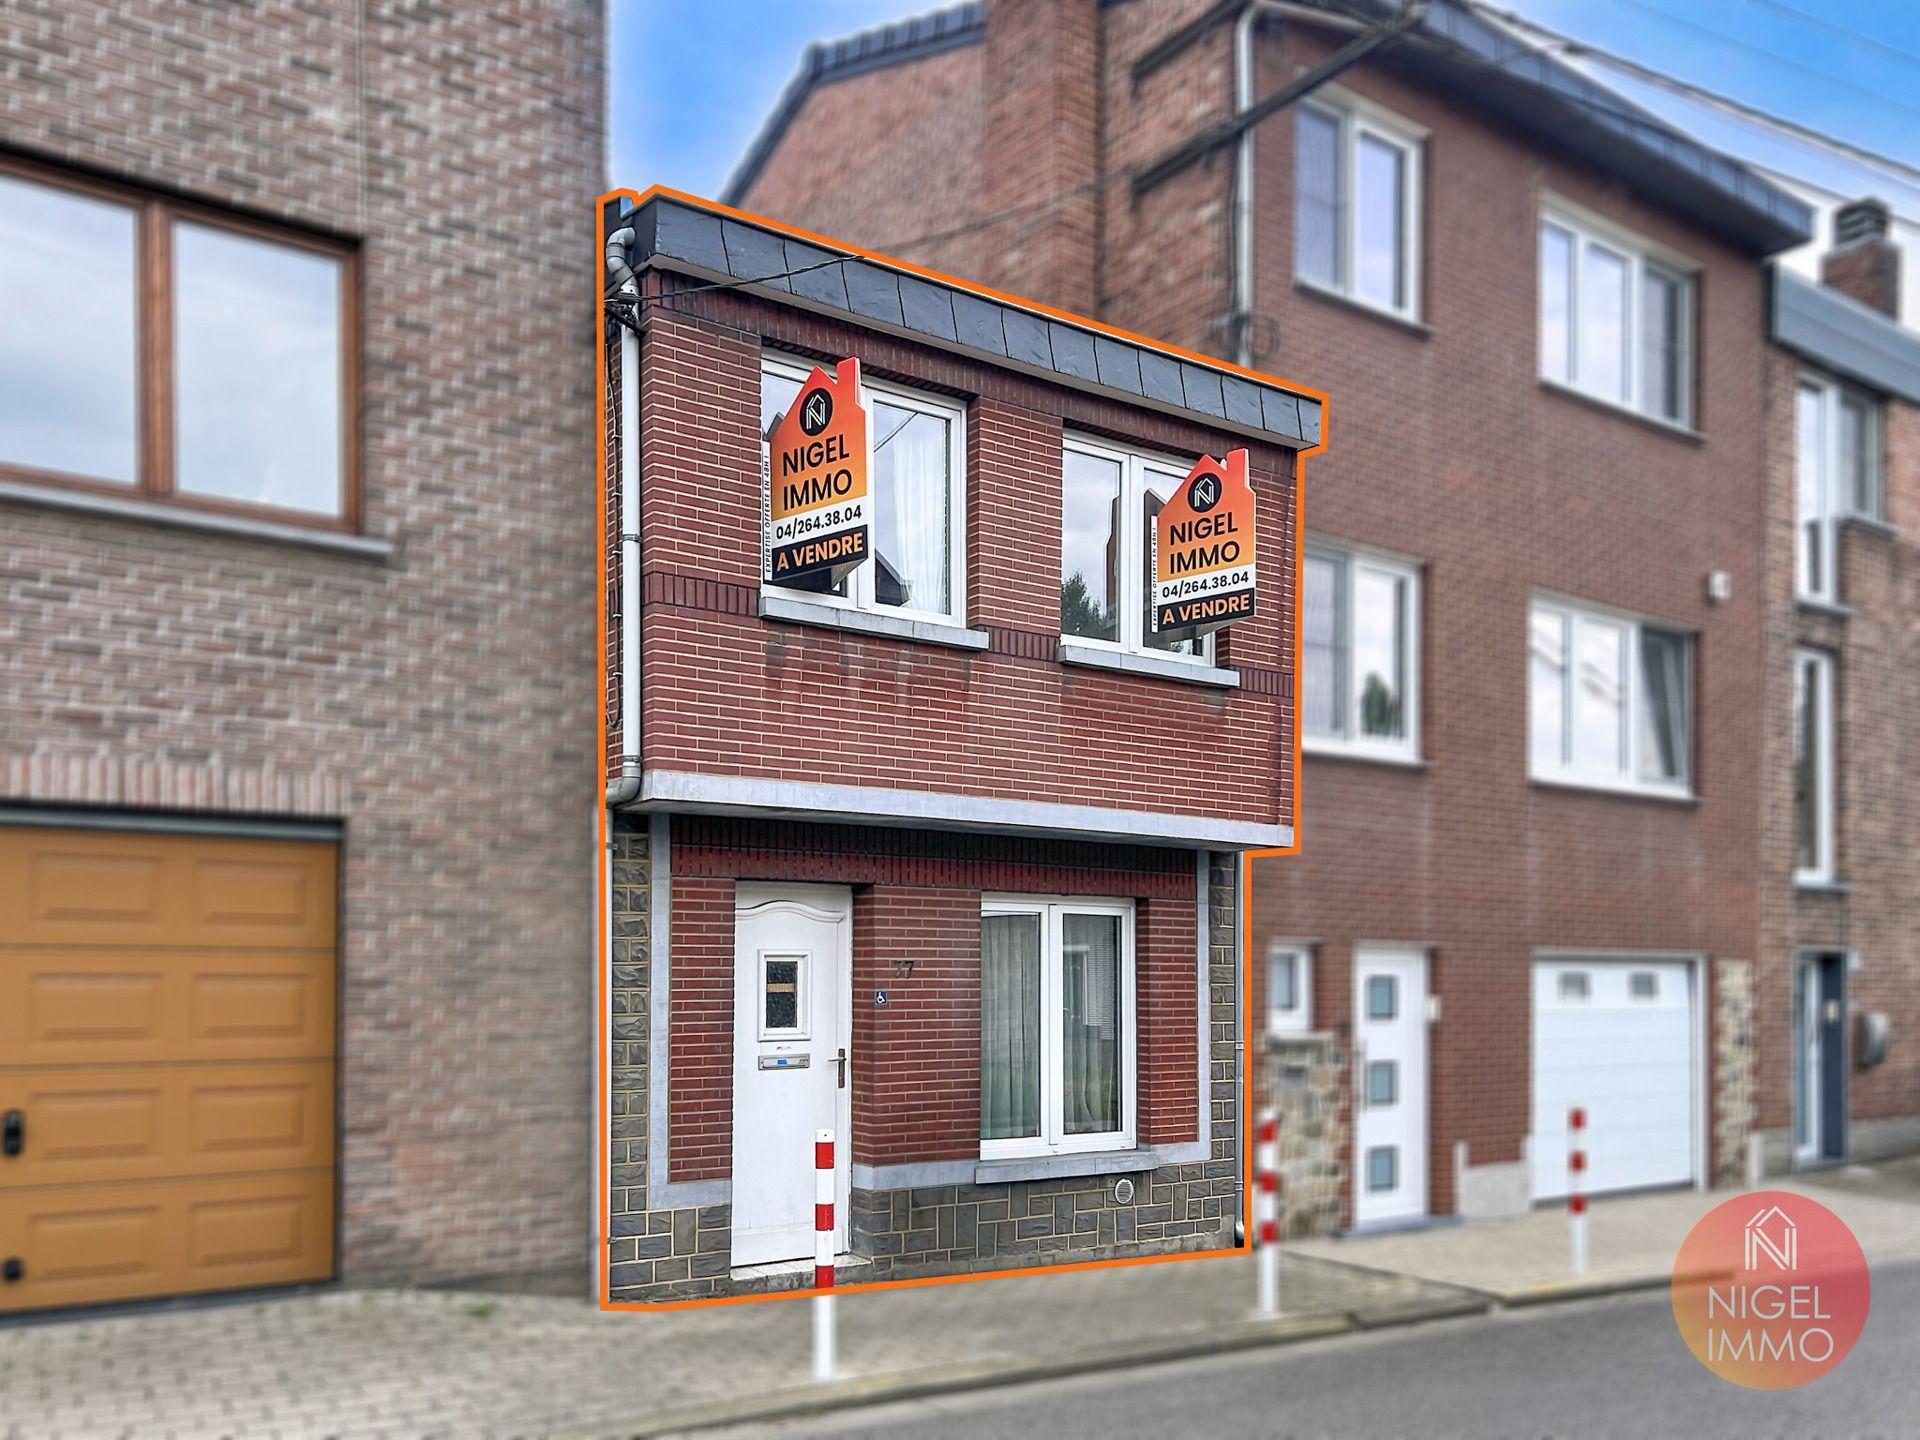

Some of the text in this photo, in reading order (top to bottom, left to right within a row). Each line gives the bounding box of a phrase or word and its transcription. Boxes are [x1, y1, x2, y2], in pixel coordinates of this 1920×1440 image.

[782, 434, 850, 477] NIGEL
[764, 481, 771, 491] EN
[783, 469, 852, 511] IMMO
[776, 504, 862, 540] 04/264.38.04
[1170, 512, 1238, 546] NIGEL
[764, 531, 772, 573] EXPERTISE
[776, 532, 864, 572] A VENDRE
[1169, 540, 1240, 575] IMMO
[1162, 571, 1249, 599] 04/264.38.04
[1162, 593, 1250, 625] A VENDRE
